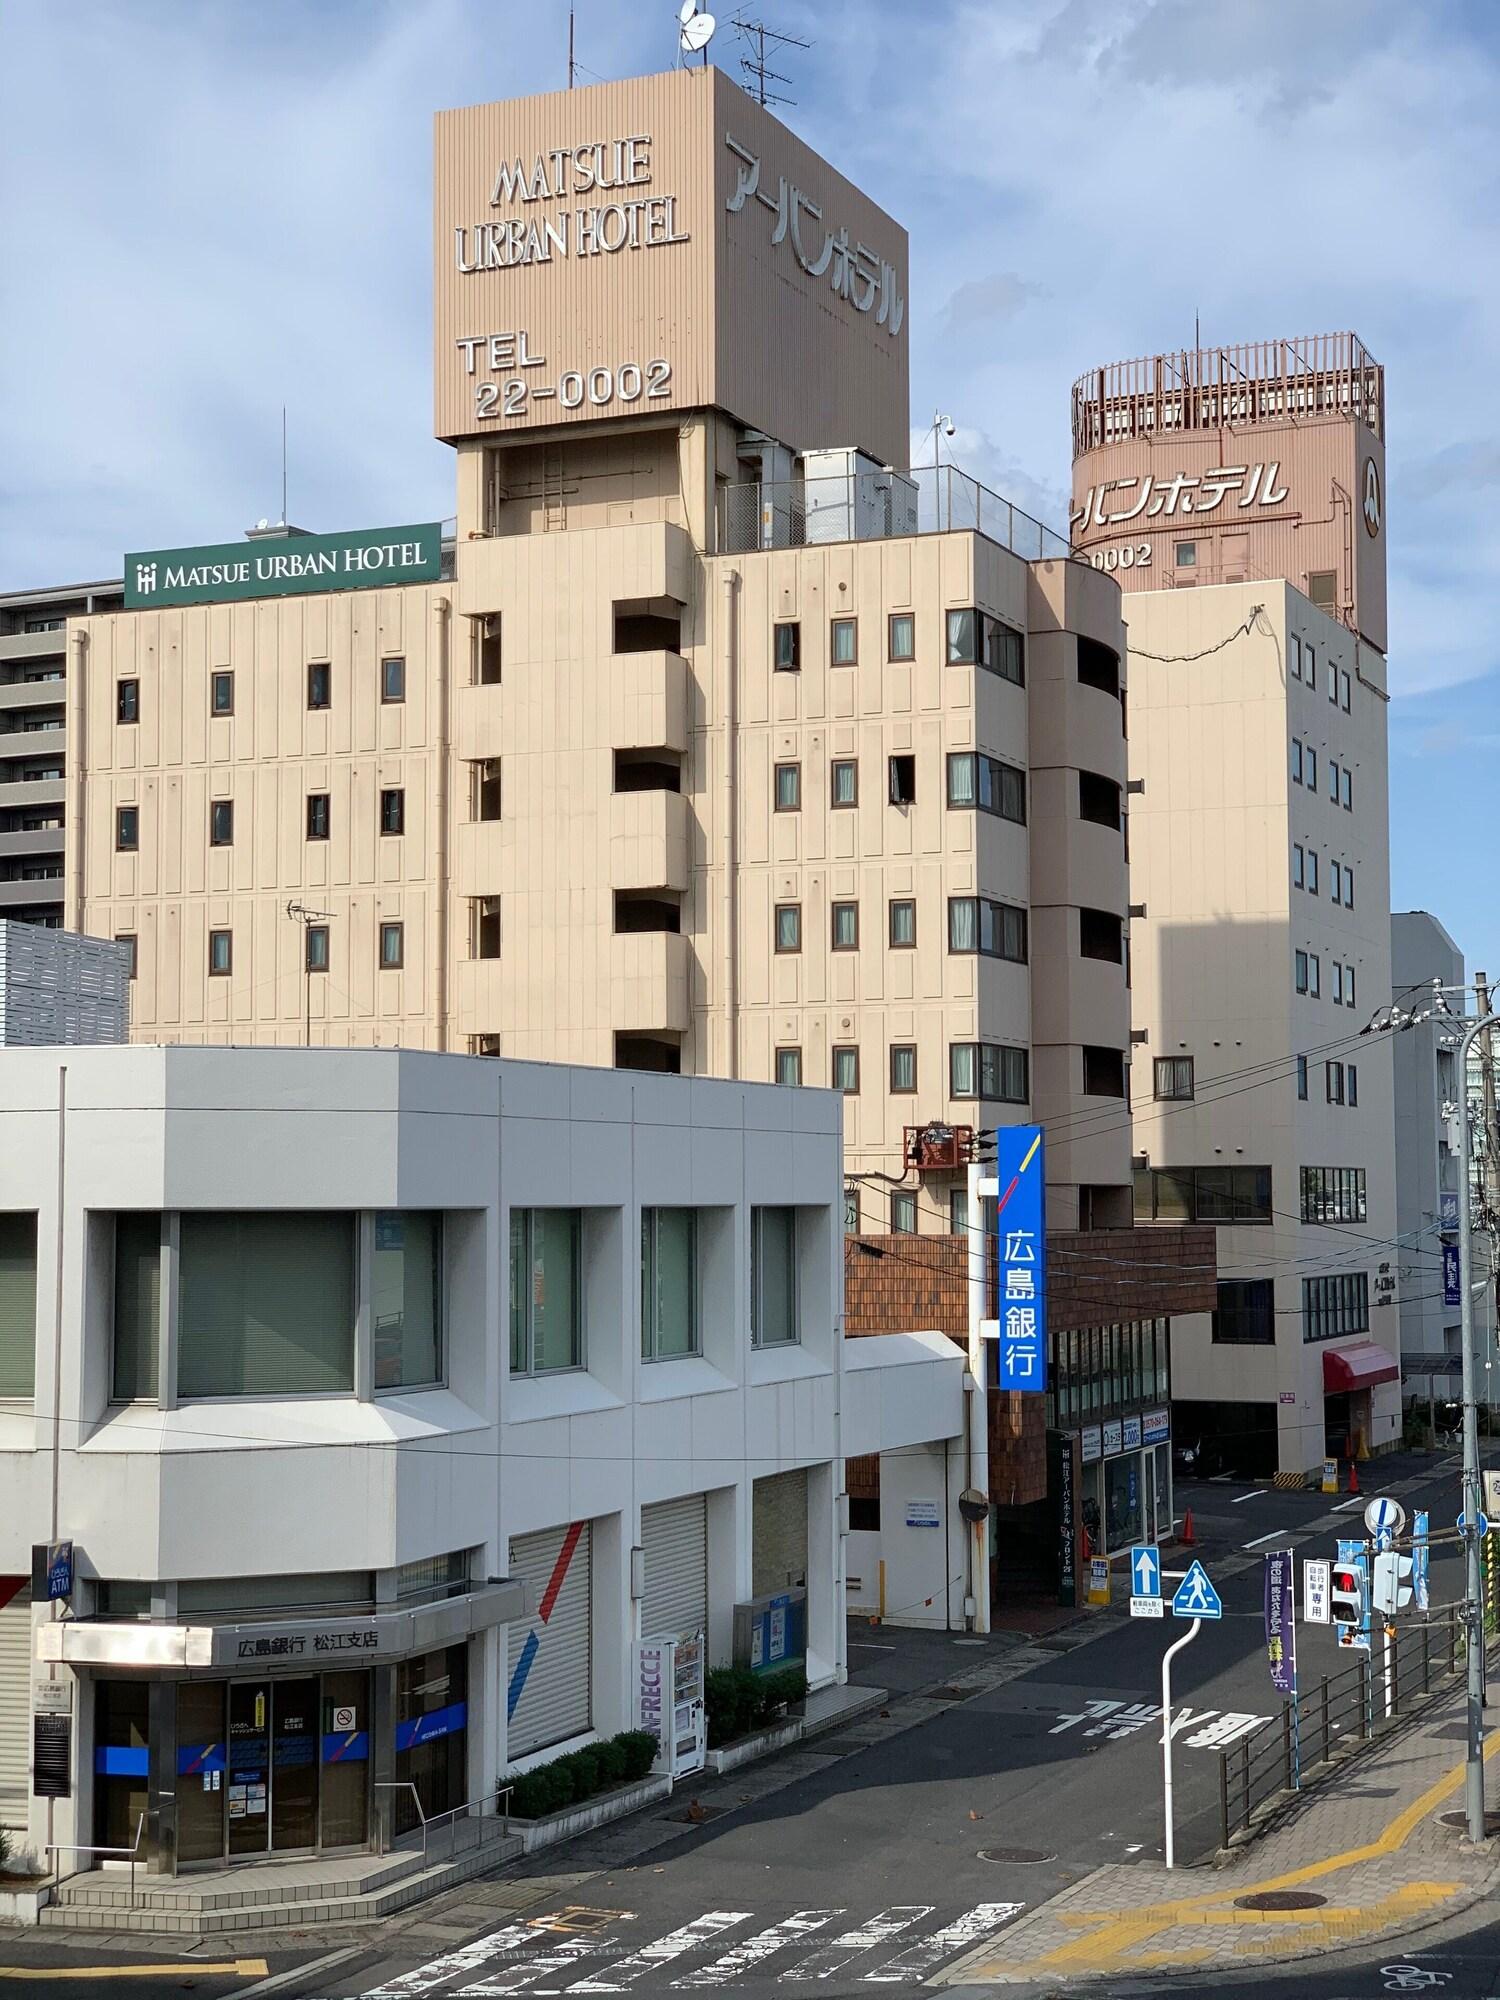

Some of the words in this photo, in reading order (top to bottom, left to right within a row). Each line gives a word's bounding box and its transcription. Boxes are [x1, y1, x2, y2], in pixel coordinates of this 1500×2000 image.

[490, 134, 652, 206] MATSUE
[454, 210, 570, 274] URBAN
[575, 194, 690, 256] HOTEL
[455, 329, 545, 374] TEL
[475, 358, 673, 420] 22-0002
[163, 562, 249, 590] MATSUE
[255, 550, 337, 580] URBAN
[343, 542, 427, 572] HOTEL
[1004, 1229, 1037, 1378] 広島銀行
[51, 1576, 70, 1595] ATM
[1309, 1566, 1317, 1590] 自転車
[1317, 1566, 1325, 1592] 歩行者
[1134, 1607, 1160, 1615] ここから
[1312, 1592, 1322, 1618] 専用
[237, 1635, 306, 1657] 広島銀行
[313, 1631, 379, 1651] 松江支店
[640, 1649, 662, 1760] NFRECCE
